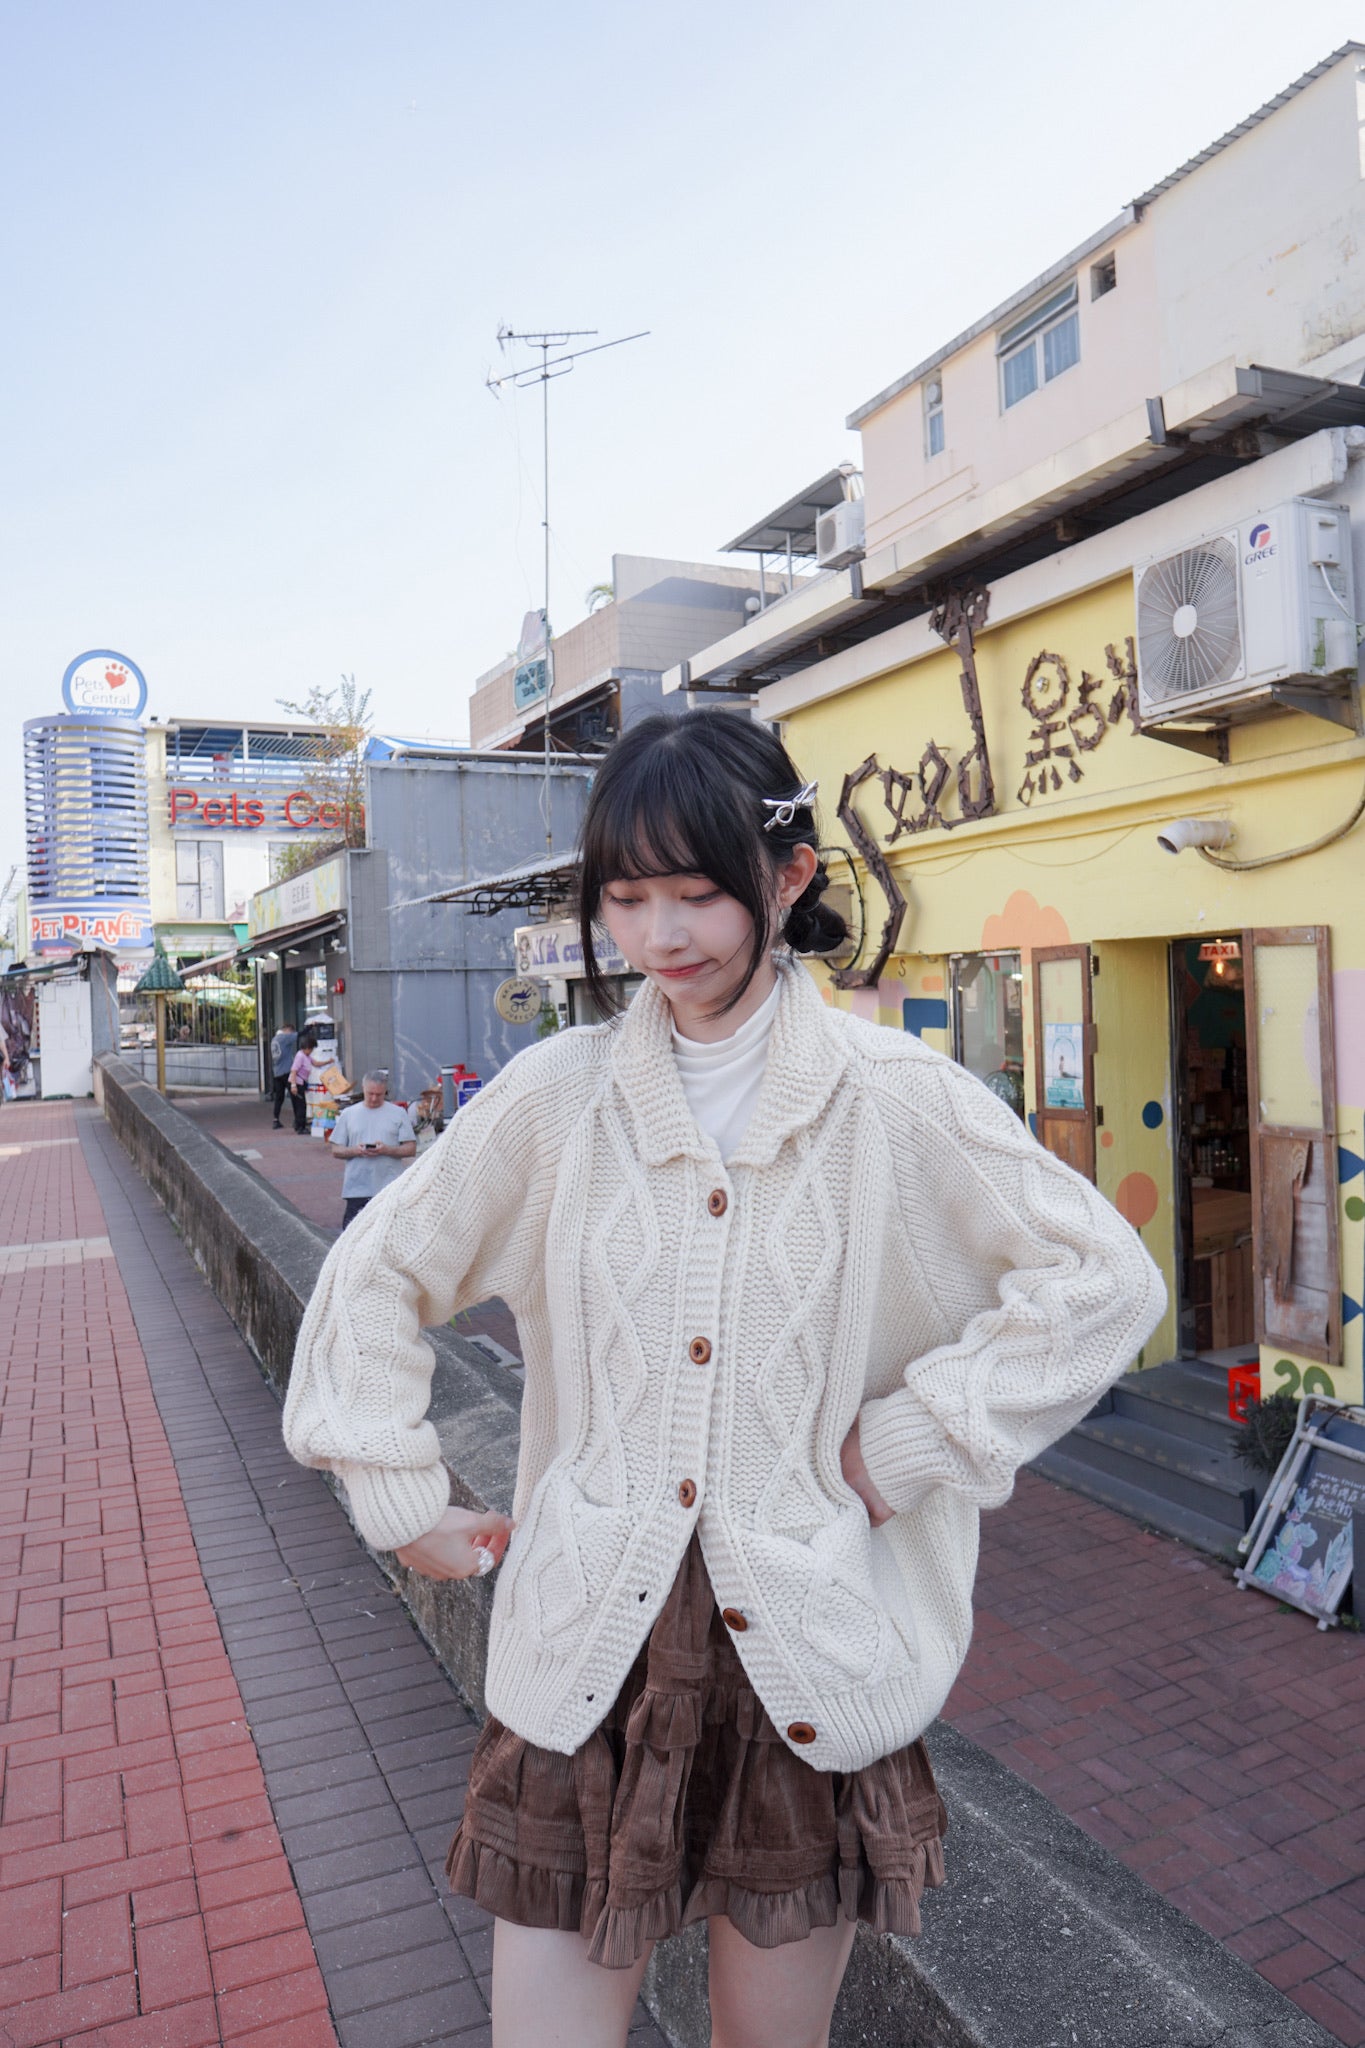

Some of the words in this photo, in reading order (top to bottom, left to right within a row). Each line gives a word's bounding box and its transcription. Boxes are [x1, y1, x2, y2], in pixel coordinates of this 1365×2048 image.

[1245, 544, 1278, 565] GREE
[75, 676, 104, 691] Pets
[82, 690, 130, 705] Central
[169, 789, 265, 827] Pets
[31, 917, 59, 939] PET
[63, 911, 142, 944] PLANET
[1202, 945, 1235, 956] TAXI
